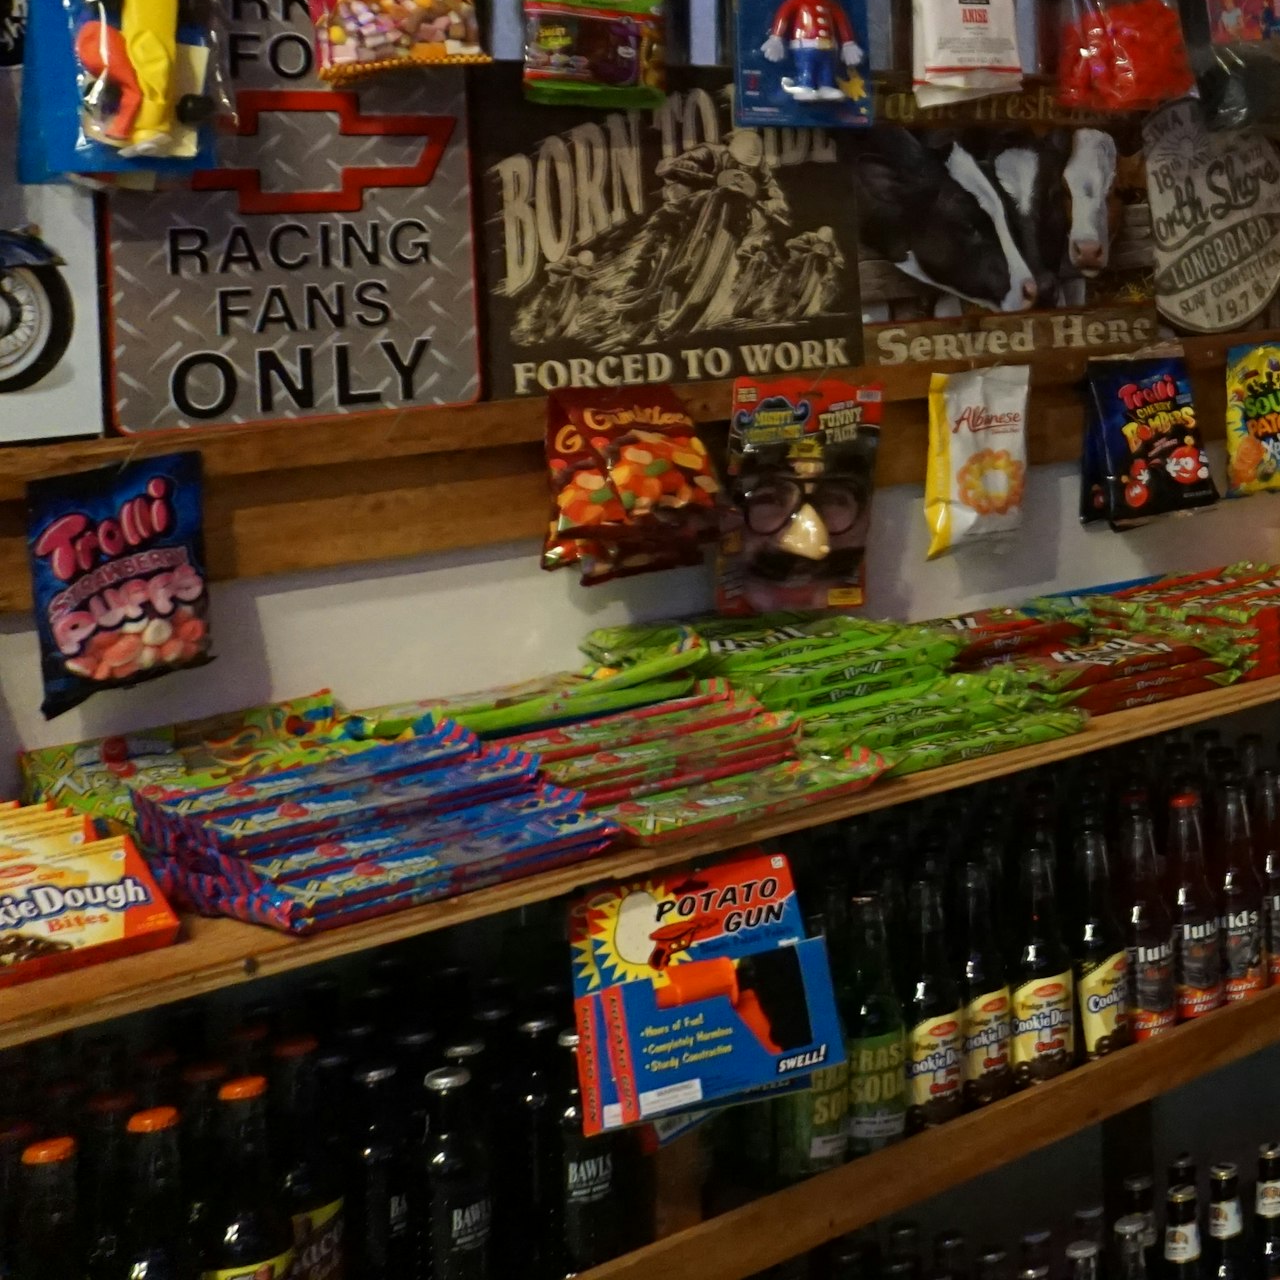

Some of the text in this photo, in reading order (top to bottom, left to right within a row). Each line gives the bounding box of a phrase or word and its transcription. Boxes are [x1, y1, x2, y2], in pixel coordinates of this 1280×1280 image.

[962, 7, 988, 24] ANISE
[494, 108, 646, 298] BORN
[166, 218, 431, 276] RACING
[1170, 219, 1272, 289] LONGBOARD
[216, 279, 392, 336] FANS
[876, 316, 1152, 366] Served Here
[168, 336, 433, 420] ONLY
[512, 336, 850, 396] FORCED TO WORK
[1118, 374, 1176, 409] Trolli
[952, 406, 1022, 435] Albanese
[35, 475, 172, 581] Trolli
[46, 911, 110, 934] Bites
[655, 877, 778, 922] POTATO
[723, 900, 785, 934] GUN
[778, 1044, 826, 1074] SWELL!
[568, 1155, 613, 1185] BAWLS
